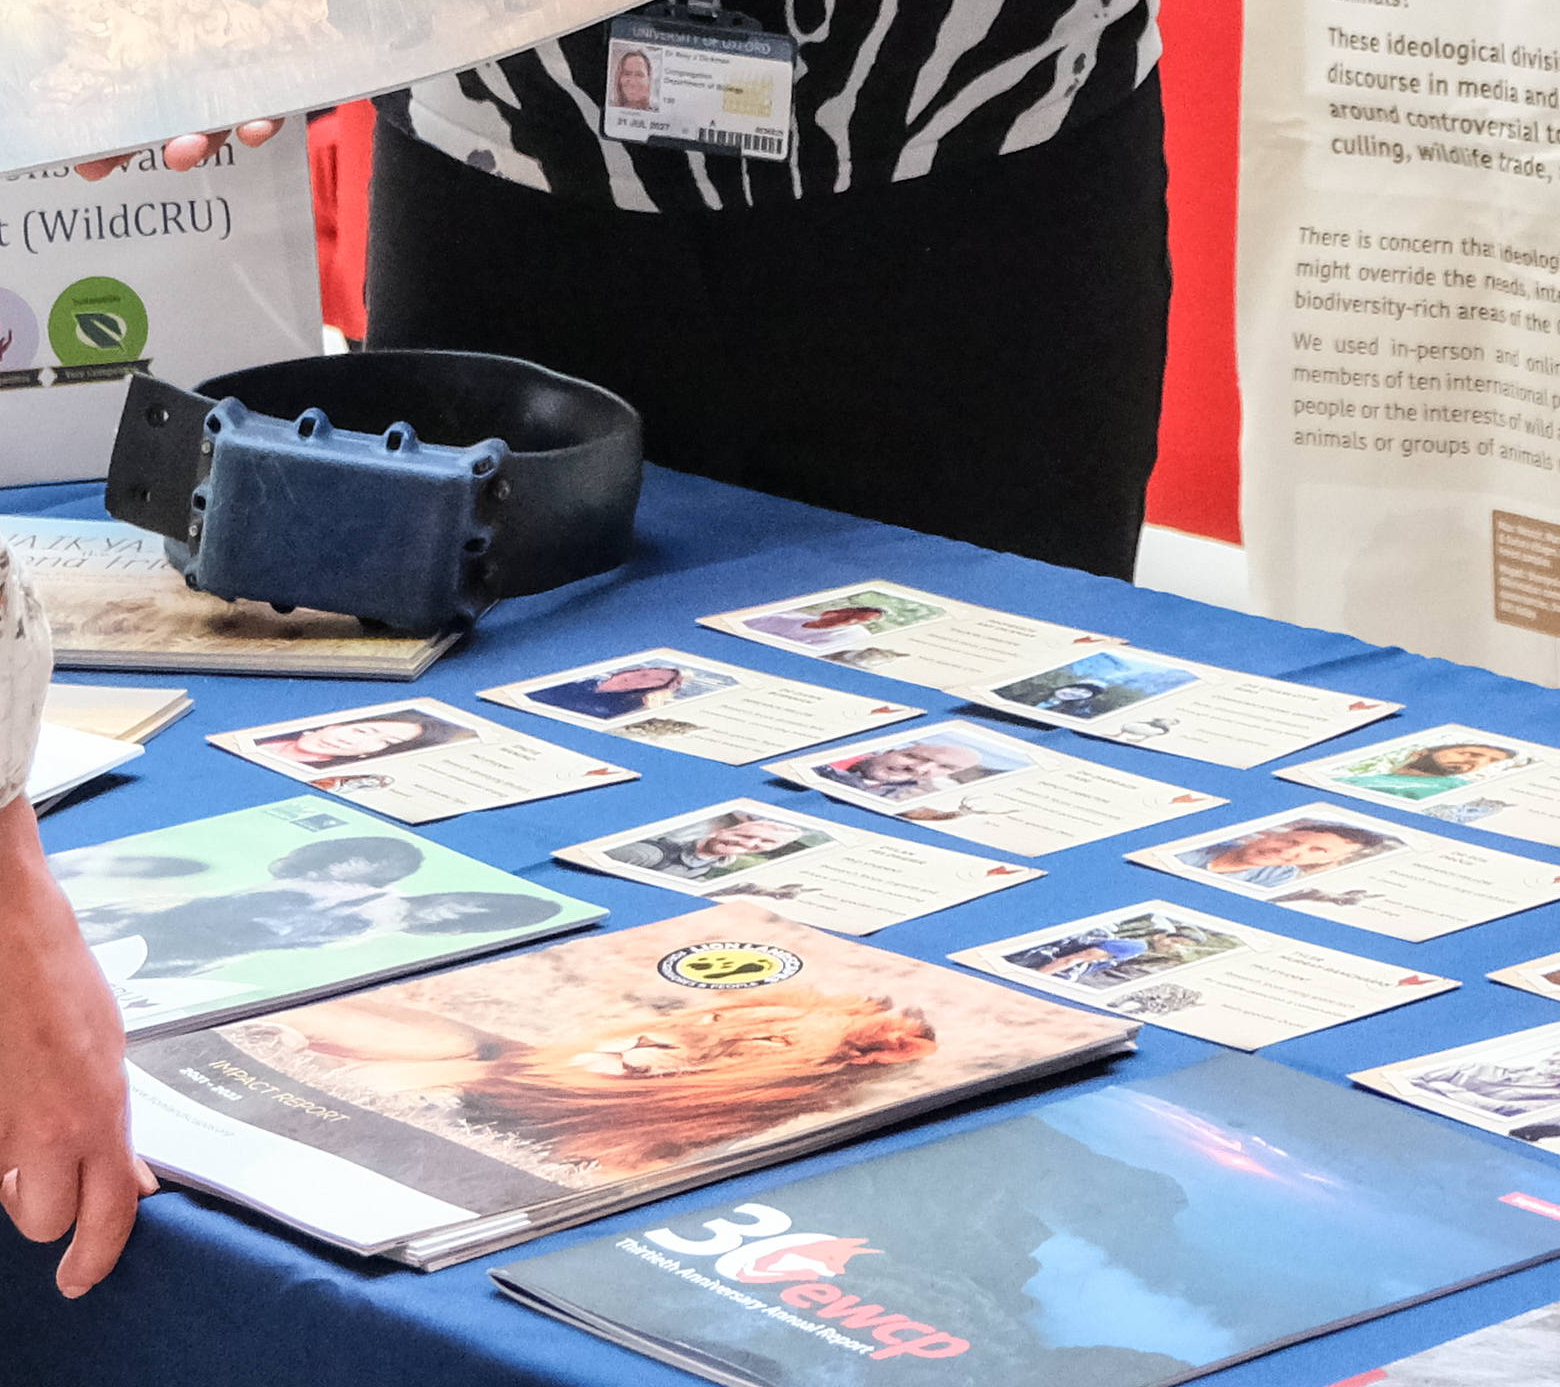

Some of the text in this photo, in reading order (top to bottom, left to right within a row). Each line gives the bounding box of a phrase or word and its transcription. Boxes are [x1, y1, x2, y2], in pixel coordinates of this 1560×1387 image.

[22, 195, 233, 255] (WildCRU)
[208, 1059, 280, 1100] IMPACT
[272, 1092, 351, 1124] REPORT
[615, 1237, 876, 1356] Thirtieth Anniversary Annual Report
[780, 1281, 971, 1361] ewcp
